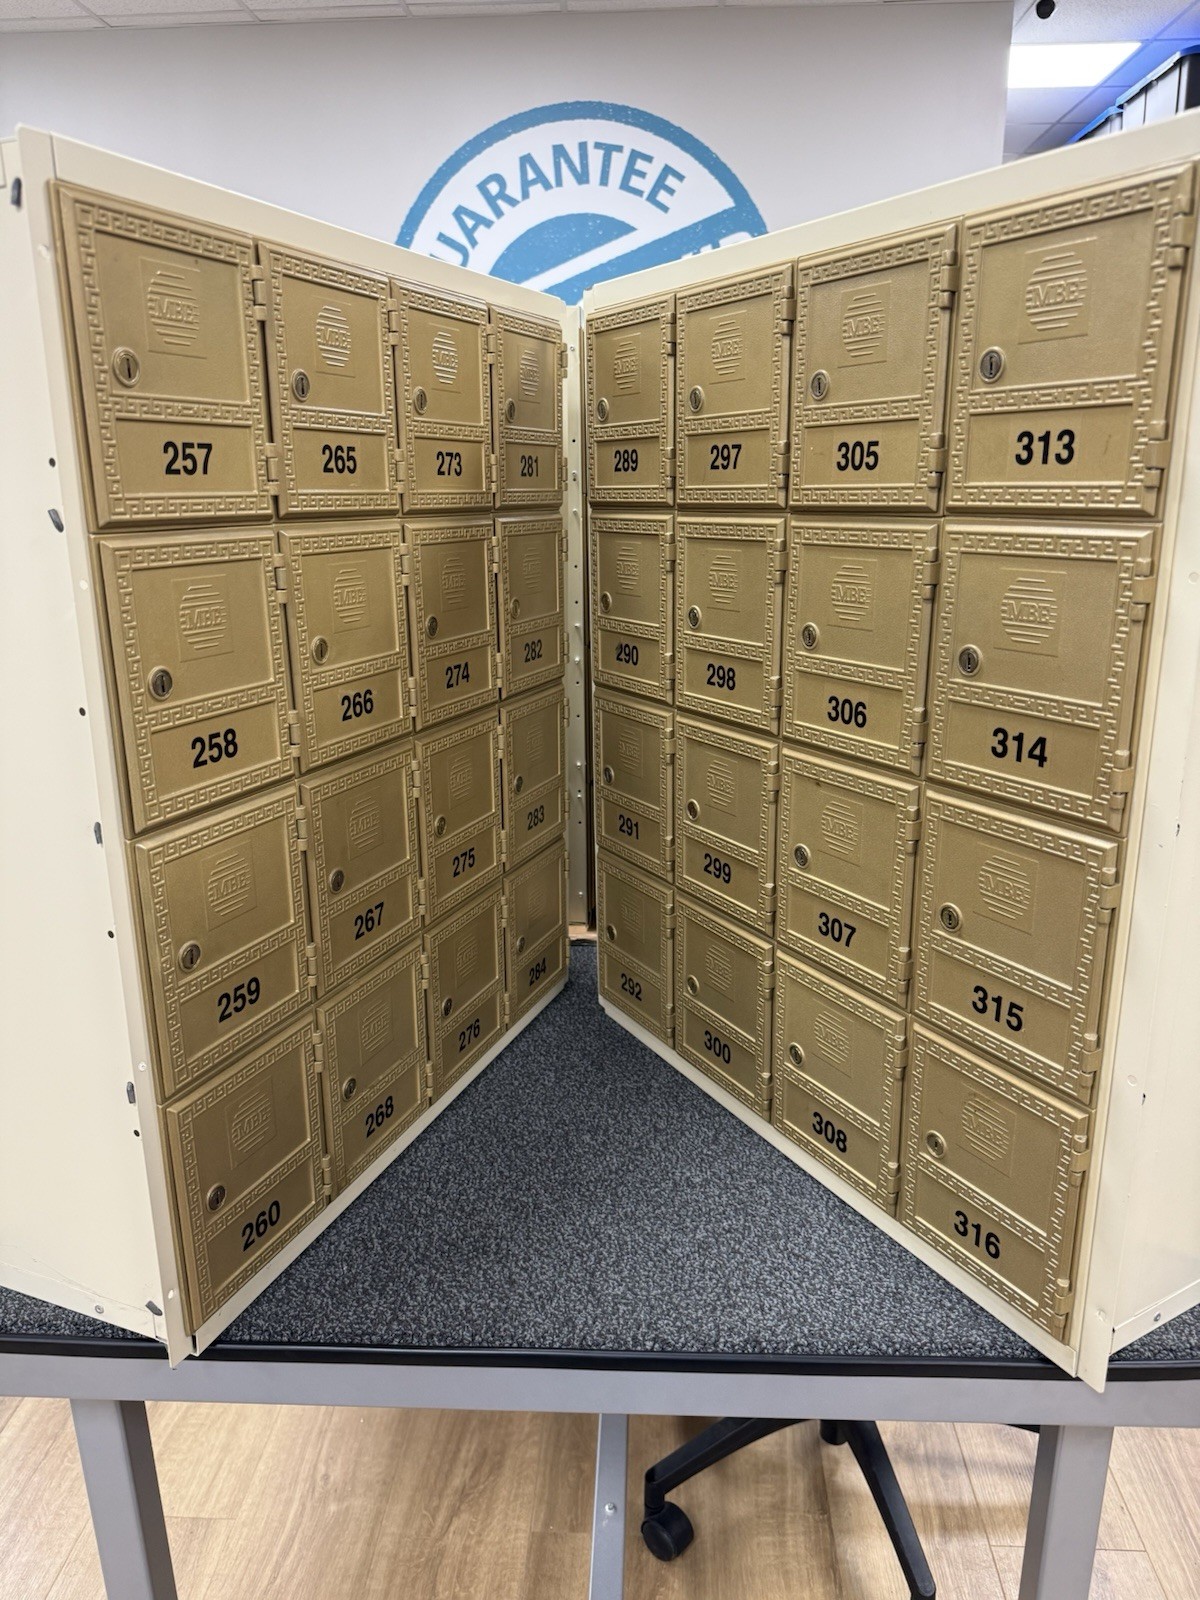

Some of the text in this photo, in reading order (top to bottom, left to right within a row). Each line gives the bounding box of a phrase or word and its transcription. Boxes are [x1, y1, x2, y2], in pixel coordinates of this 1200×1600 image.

[163, 440, 213, 476] 257
[321, 444, 357, 475] 265
[614, 448, 639, 473] 289
[710, 443, 742, 471] 297
[836, 440, 880, 472] 305
[1015, 429, 1075, 466] 313
[436, 451, 463, 477] 273
[520, 454, 539, 478] 281
[524, 639, 543, 663] 282
[616, 643, 639, 666] 290
[445, 661, 470, 690] 274
[706, 663, 736, 691] 298
[341, 689, 374, 722] 266
[827, 695, 867, 729] 306
[191, 728, 239, 769] 258
[991, 727, 1048, 768] 314
[527, 804, 545, 831] 283
[618, 814, 639, 840] 291
[452, 846, 476, 878] 275
[703, 852, 732, 884] 299
[354, 901, 385, 941] 267
[817, 911, 857, 948] 307
[529, 957, 547, 987] 284
[620, 972, 642, 1002] 292
[217, 976, 261, 1024] 259
[971, 985, 1024, 1032] 315
[458, 1017, 482, 1053] 276
[704, 1030, 731, 1065] 300
[364, 1094, 395, 1138] 268
[812, 1111, 848, 1153] 308
[241, 1199, 282, 1253] 260
[953, 1210, 1001, 1260] 316
